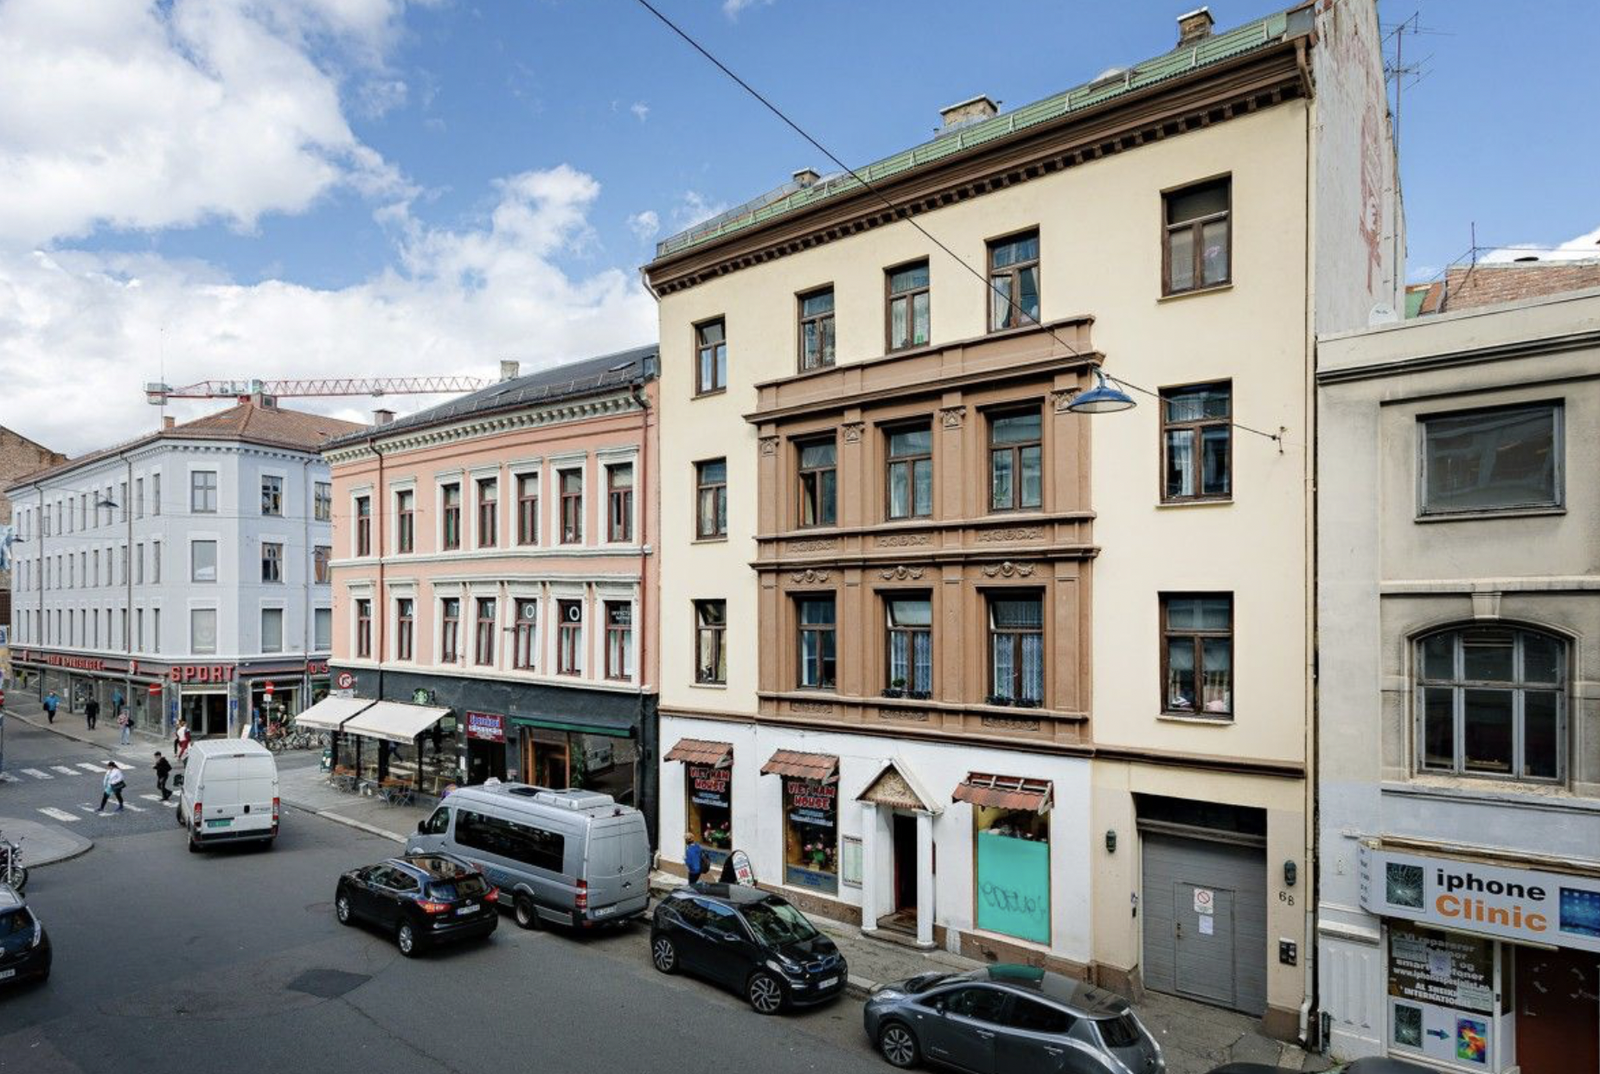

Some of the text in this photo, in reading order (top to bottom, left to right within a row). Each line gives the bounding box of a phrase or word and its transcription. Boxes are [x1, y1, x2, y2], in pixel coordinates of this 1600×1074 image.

[170, 665, 236, 682] SPORT
[694, 779, 726, 793] HOUSE
[788, 781, 836, 798] VIET NAM
[794, 796, 830, 810] HOUSE
[1437, 868, 1546, 901] iphone
[1436, 894, 1547, 932] Clinic
